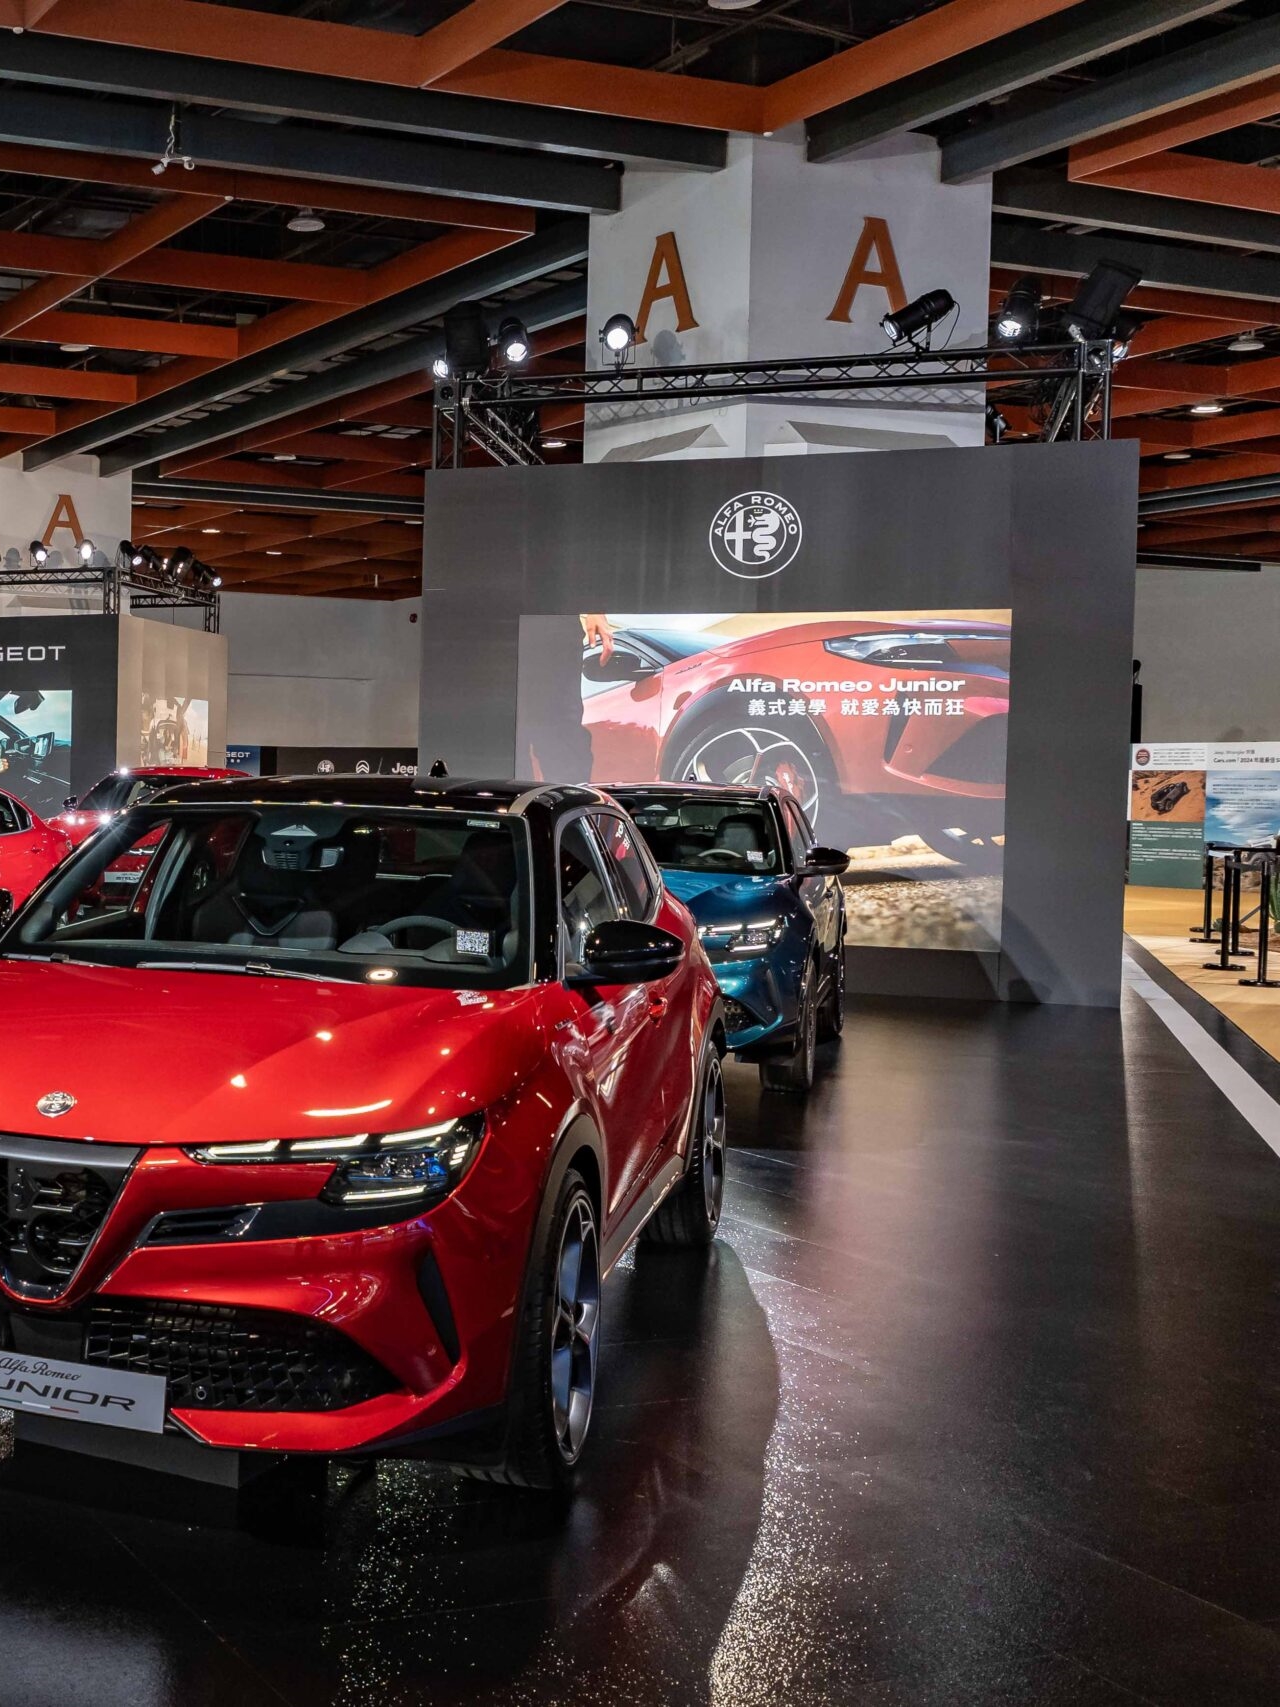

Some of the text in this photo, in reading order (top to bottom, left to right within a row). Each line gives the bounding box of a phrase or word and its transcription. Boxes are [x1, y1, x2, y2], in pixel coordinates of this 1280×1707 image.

[628, 231, 700, 347] A
[825, 216, 908, 323] A
[40, 494, 85, 549] A
[714, 495, 798, 537] ALFA ROMEO
[727, 677, 966, 693] Alfa Romeo Junior
[748, 699, 965, 716] 義式美學 就愛為快而狂
[29, 1361, 82, 1381] Romeo
